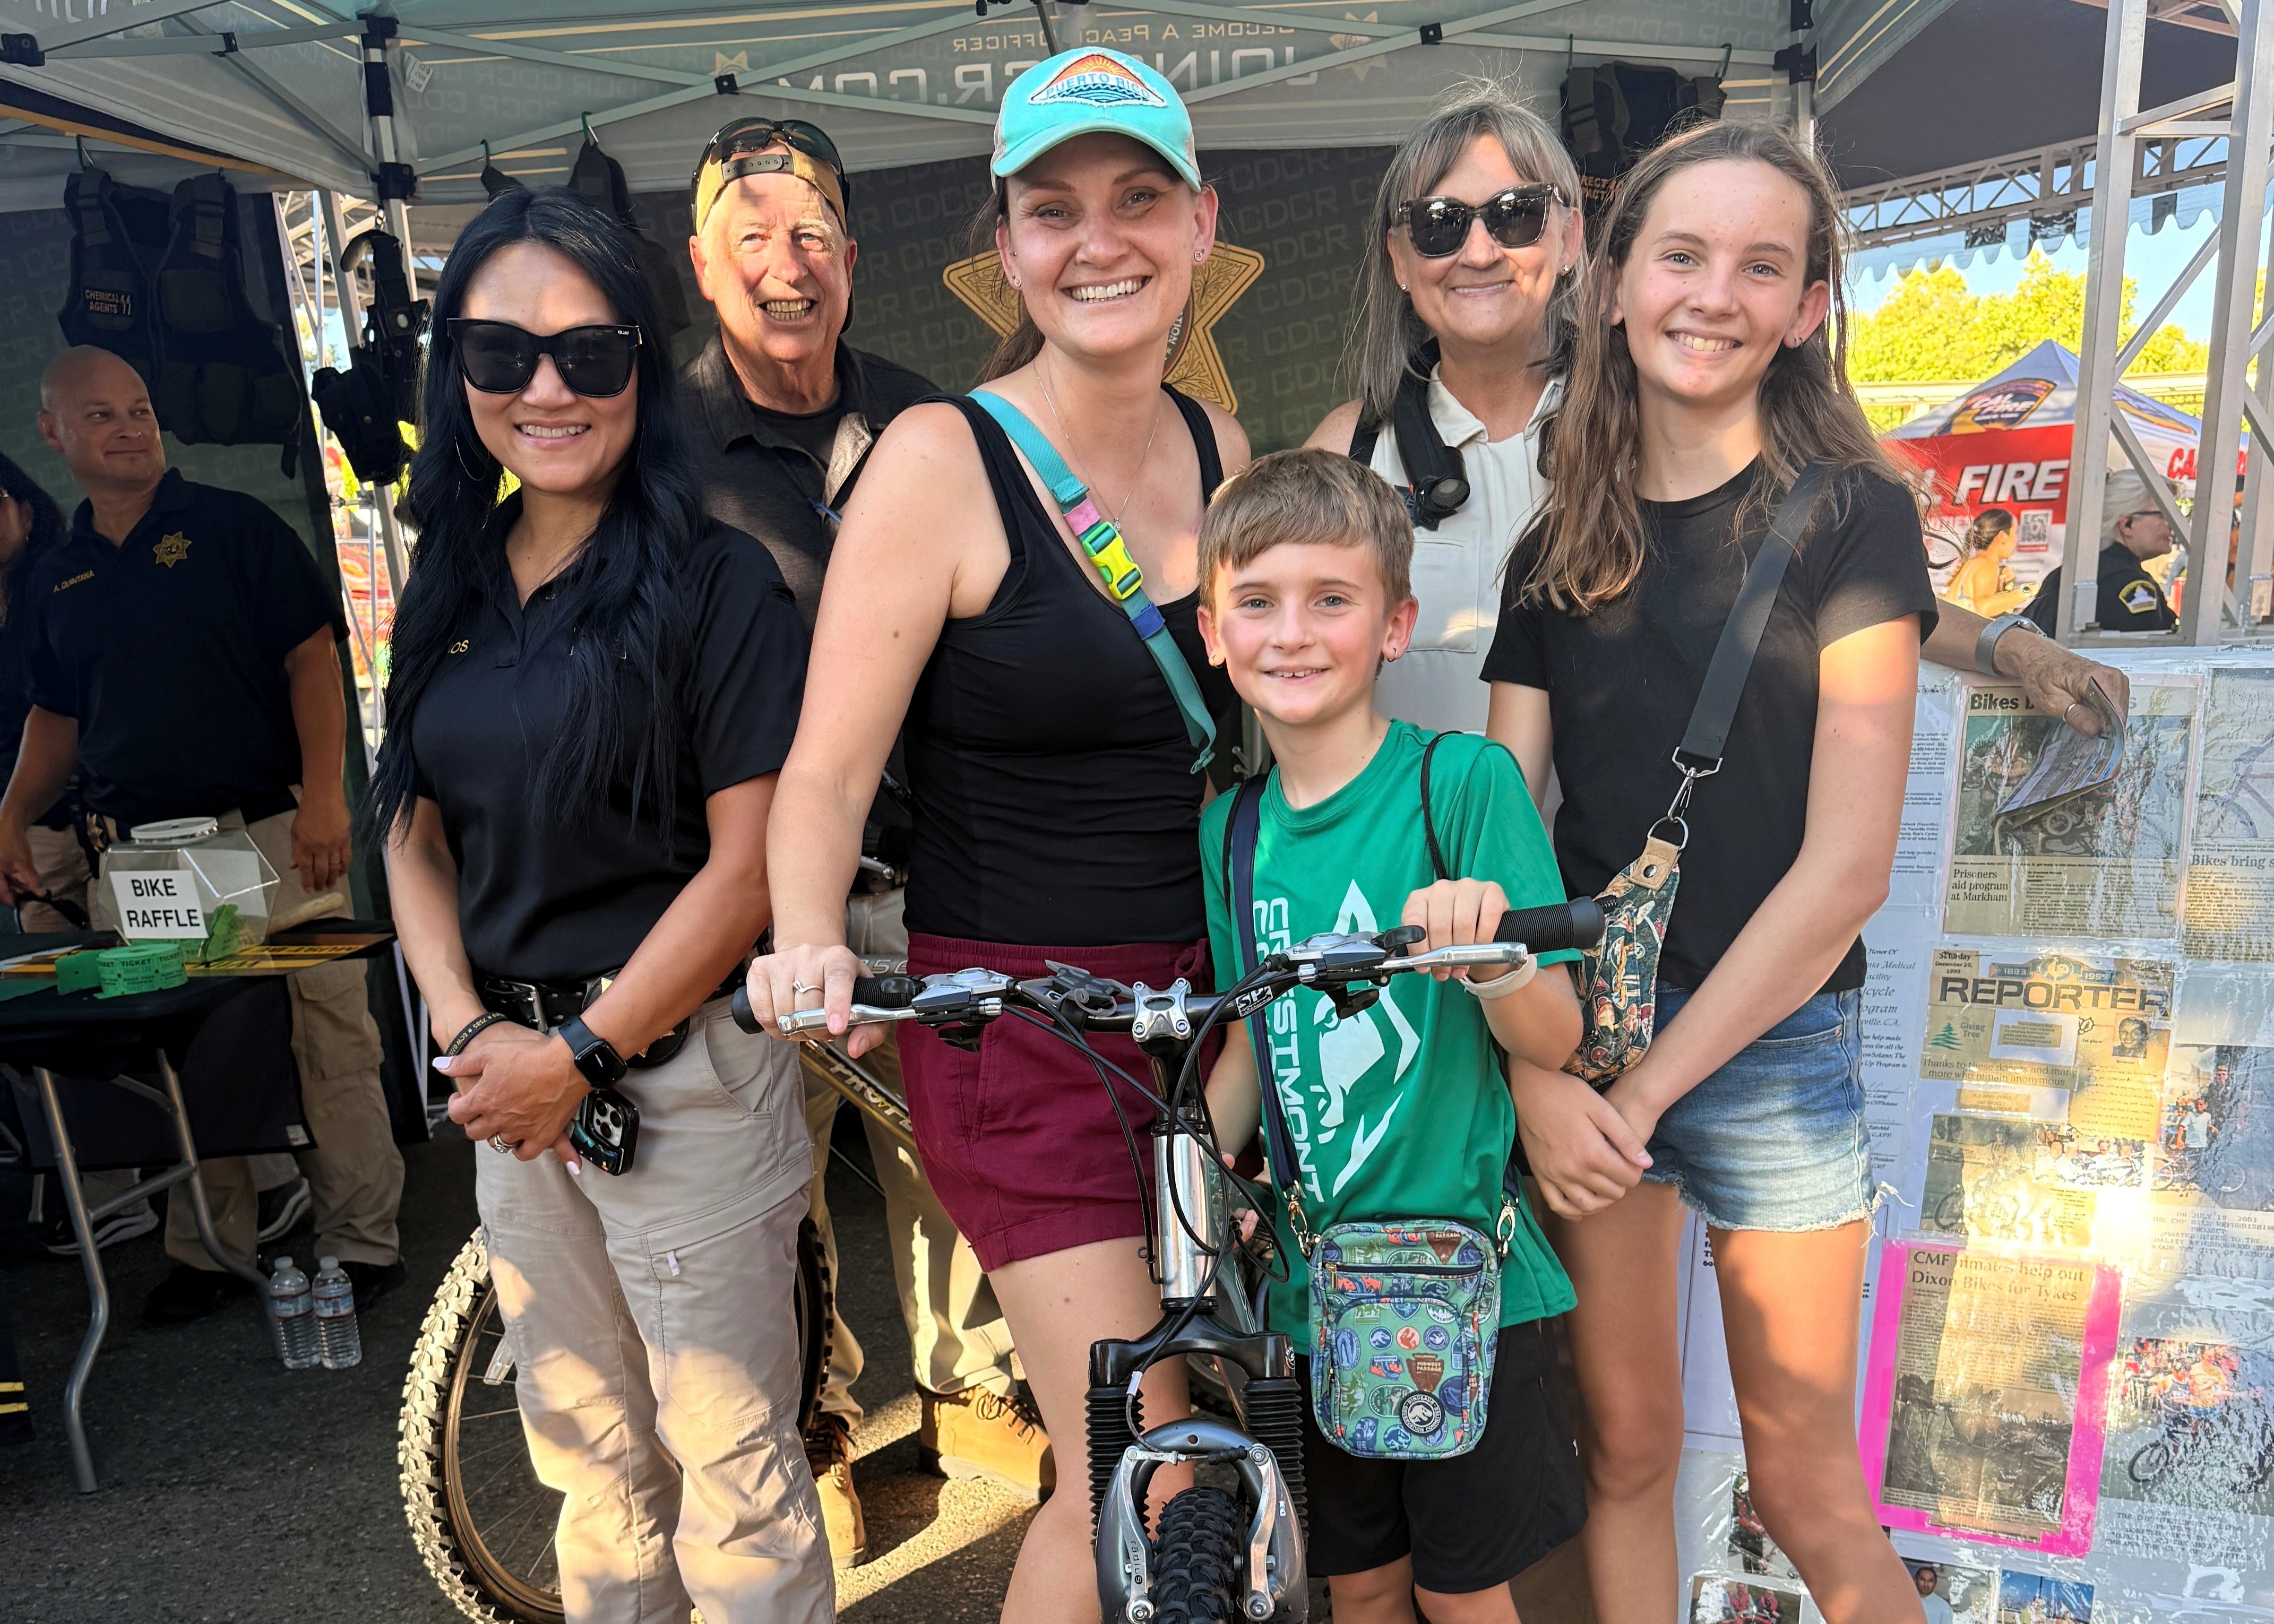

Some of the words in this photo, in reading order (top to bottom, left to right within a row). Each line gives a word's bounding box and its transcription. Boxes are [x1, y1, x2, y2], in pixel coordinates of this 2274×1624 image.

[1046, 73, 1109, 99] PUERTO
[1116, 76, 1149, 98] RICO
[1237, 185, 1339, 235] CDCR
[85, 289, 119, 304] CHEMICAL
[89, 301, 117, 314] AGENTS
[2167, 448, 2197, 480] CA
[1952, 460, 2070, 506] FIRE
[1970, 694, 2018, 710] Bikes
[2192, 854, 2227, 866] Bikes
[2232, 856, 2266, 869] bring
[1954, 869, 1997, 878] Prisoners
[131, 878, 177, 897] BIKE
[1952, 881, 1966, 889] aid
[1969, 883, 2008, 894] program
[1963, 893, 2008, 902] Markham
[126, 909, 200, 928] RAFFLE
[119, 958, 151, 967] TICKET
[1866, 972, 1892, 981] acility
[1863, 987, 1895, 997] icycle
[1939, 977, 2169, 1017] REPORTER
[1863, 1005, 1898, 1015] ogram
[1960, 1022, 1985, 1032] Giving
[1963, 1030, 1981, 1038] Tree
[1269, 897, 1325, 1203] CRSTMONT
[1923, 1059, 1954, 1068] Thanks
[1968, 1062, 1994, 1071] these
[2031, 1065, 2049, 1074] and
[2052, 1067, 2077, 1078] many
[1955, 1071, 1974, 1079] who
[1976, 1074, 2008, 1082] remain
[2010, 1076, 2068, 1086] anonymous.
[1914, 1251, 1950, 1266] CMF
[2019, 1262, 2052, 1281] help
[2058, 1269, 2084, 1282] out
[1912, 1271, 1956, 1287] Dixon
[1963, 1276, 2003, 1291] Bikes
[2009, 1281, 2030, 1294] for
[2037, 1285, 2077, 1302] Tykes
[1407, 1394, 1435, 1406] DINOSAUR
